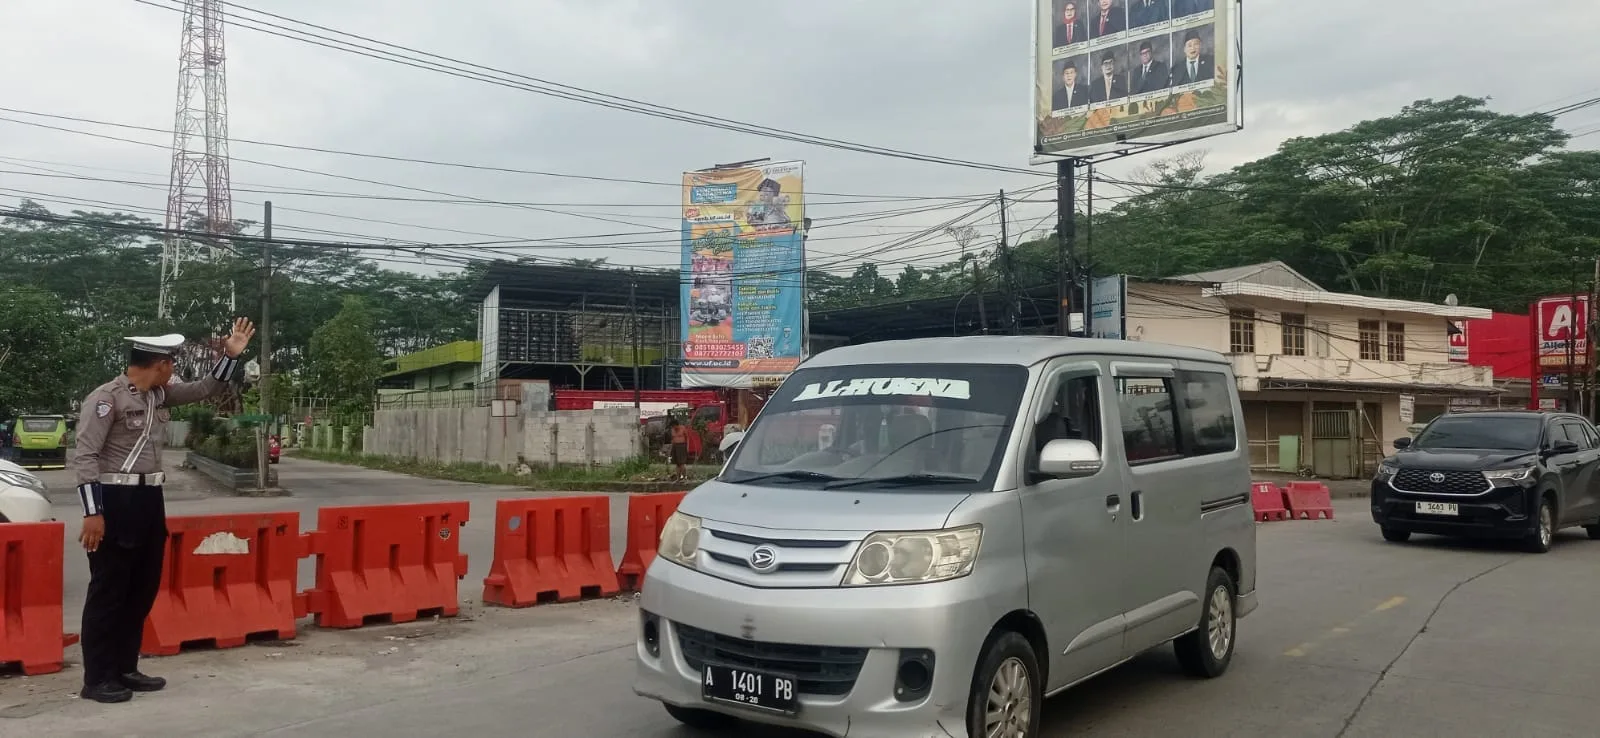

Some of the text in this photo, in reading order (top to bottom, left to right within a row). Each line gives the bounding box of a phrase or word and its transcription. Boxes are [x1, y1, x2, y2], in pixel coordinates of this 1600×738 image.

[705, 666, 792, 700] A 1401 PB
